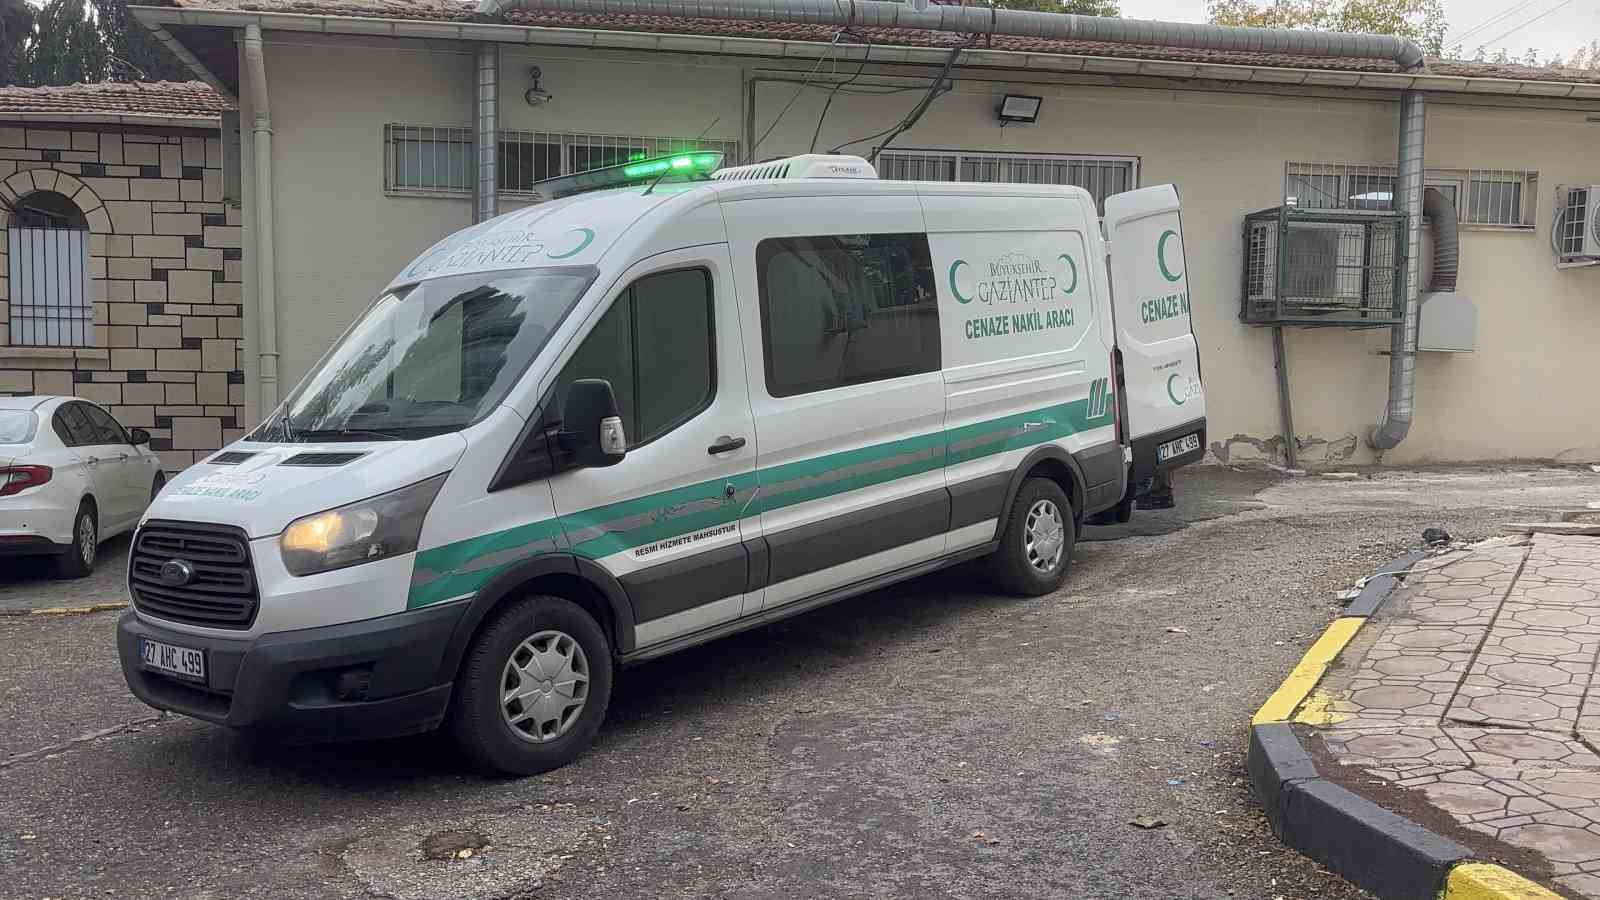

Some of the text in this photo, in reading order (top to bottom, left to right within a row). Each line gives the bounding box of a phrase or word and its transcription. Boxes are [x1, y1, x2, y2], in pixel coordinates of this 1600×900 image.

[978, 277, 1057, 306] GAZİANTEP
[965, 308, 1074, 340] CENAZE NAKİL ARACI
[1141, 294, 1179, 324] CENAZE
[635, 524, 736, 558] RESMİ HİZMETE MAHSUSTUR
[145, 641, 202, 674] 27 AHC 499
